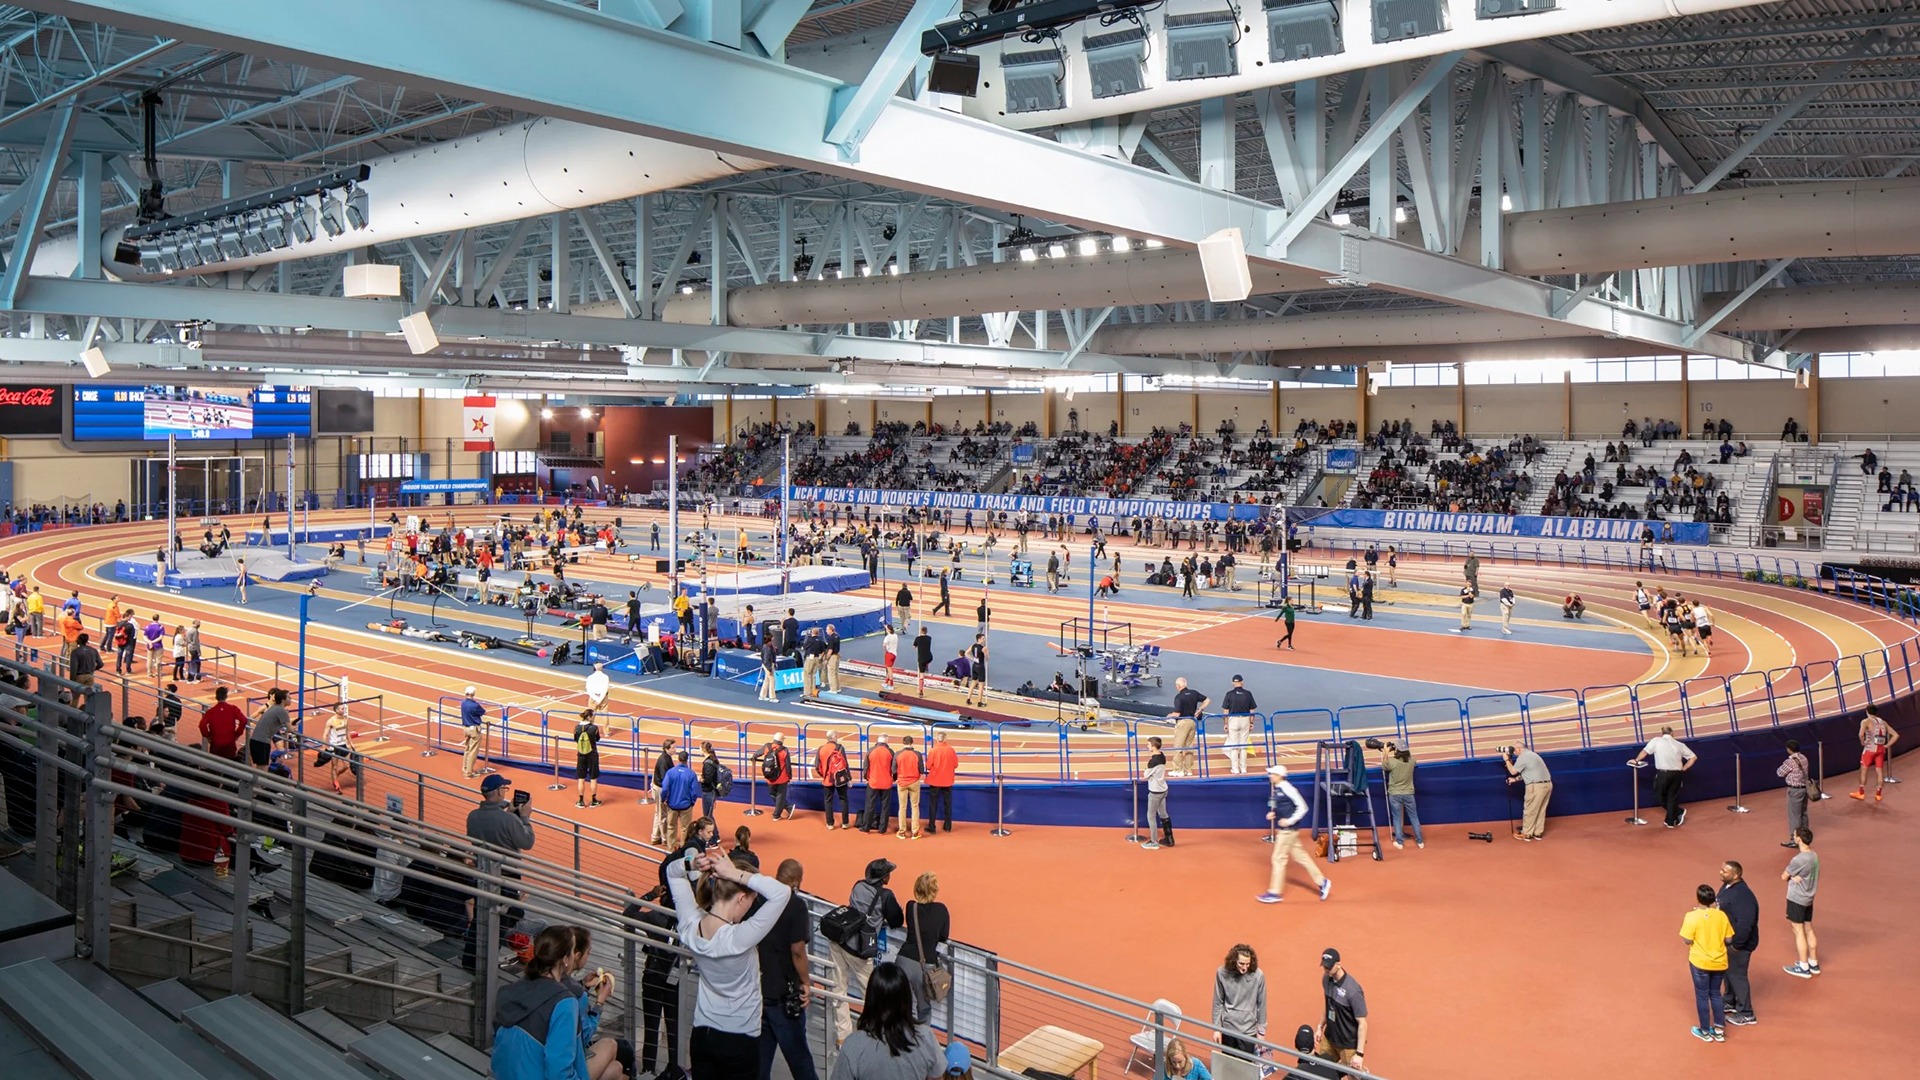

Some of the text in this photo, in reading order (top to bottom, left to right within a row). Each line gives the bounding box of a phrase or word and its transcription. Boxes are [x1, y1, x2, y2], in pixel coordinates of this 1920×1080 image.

[1286, 406, 1296, 415] 12
[1700, 402, 1713, 412] 10
[881, 410, 889, 418] 15
[997, 409, 1004, 417] 14
[1132, 408, 1140, 416] 13
[824, 488, 854, 502] MEN'S
[857, 490, 878, 503] AND
[880, 490, 930, 506] WOMEN'S
[933, 493, 976, 508] INDOOR
[980, 495, 1017, 510] TRACK
[1019, 497, 1046, 512] AND
[1050, 499, 1086, 513] FIELD
[1089, 499, 1212, 519] CHAMPIONSHIPS
[1383, 512, 1645, 540] BIRMINGHAM, ALABAMA
